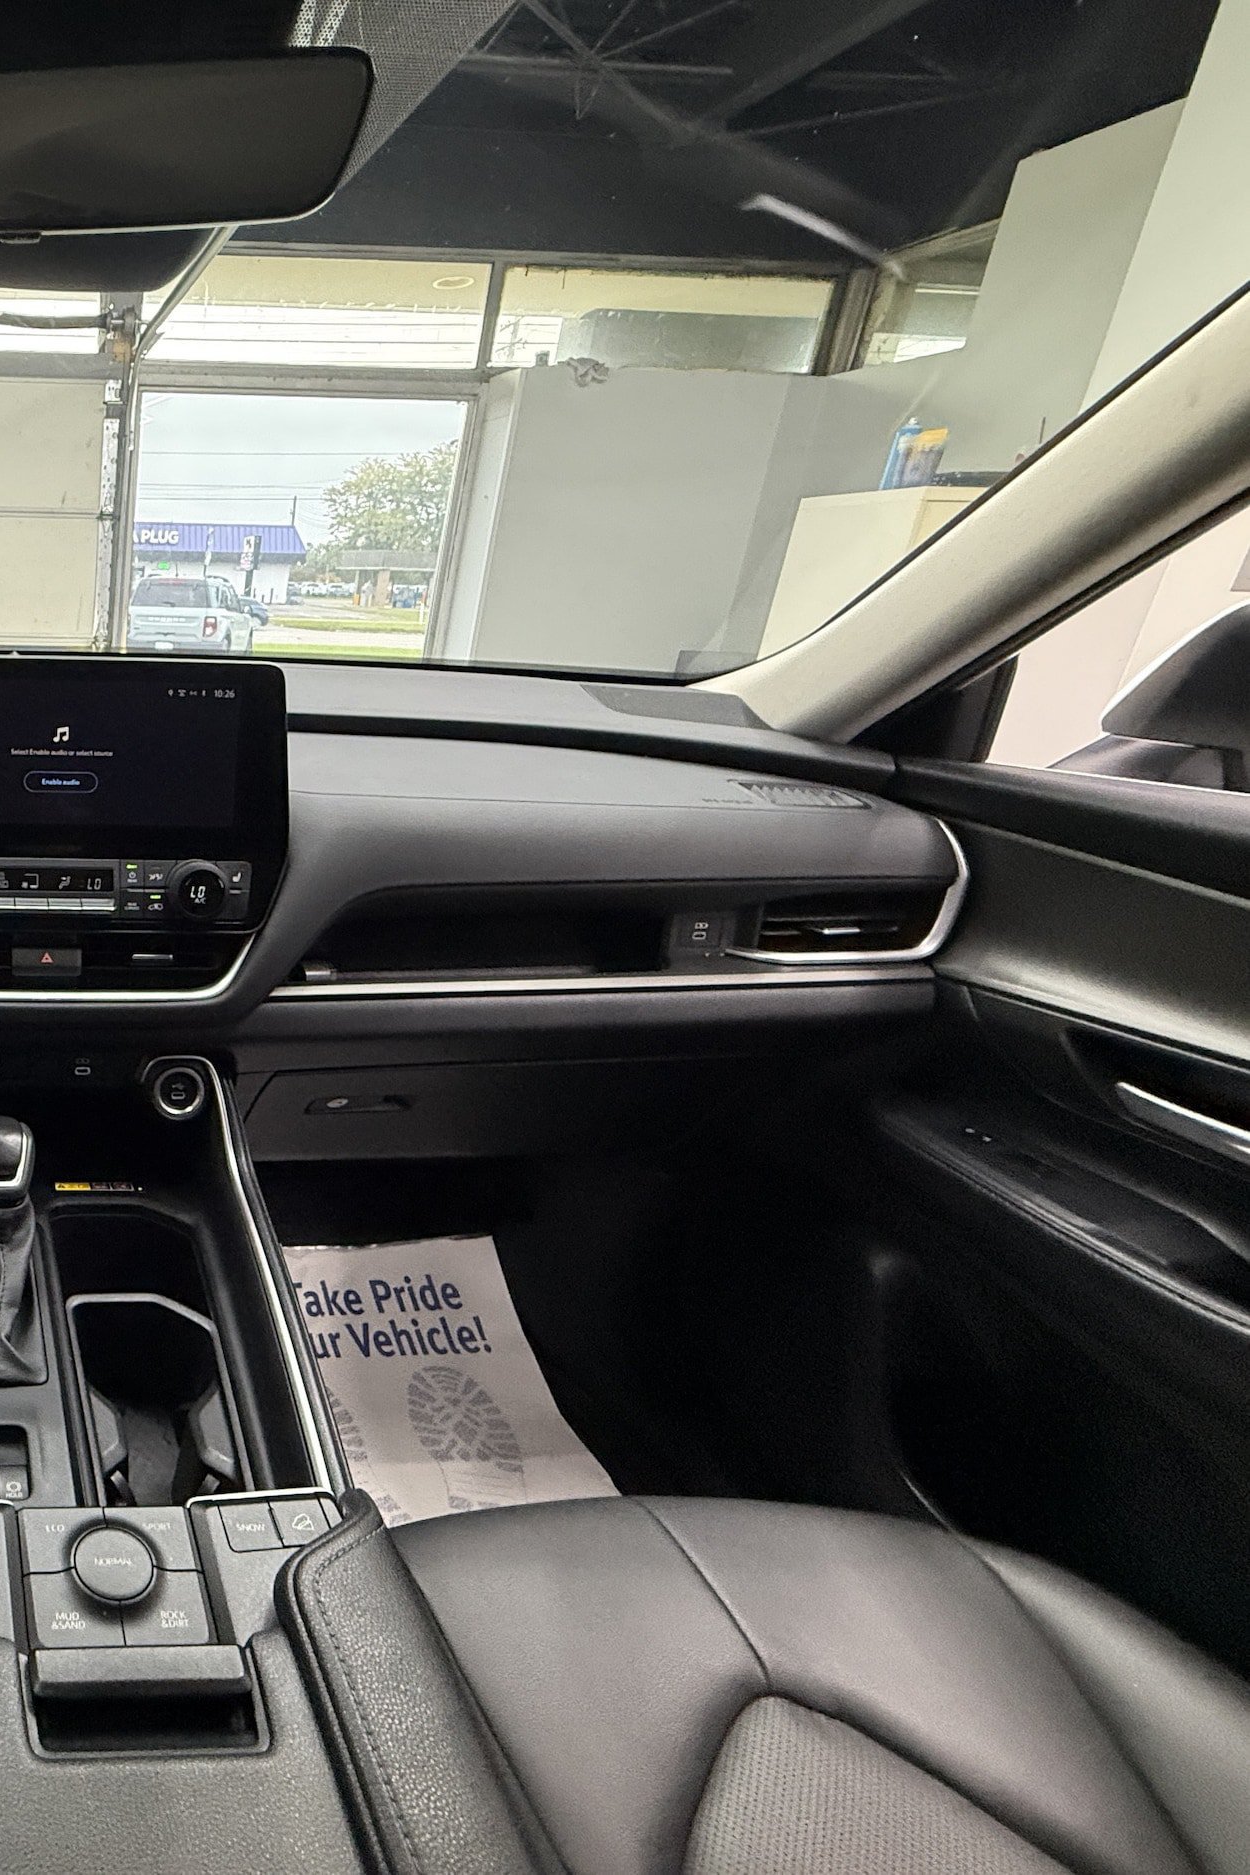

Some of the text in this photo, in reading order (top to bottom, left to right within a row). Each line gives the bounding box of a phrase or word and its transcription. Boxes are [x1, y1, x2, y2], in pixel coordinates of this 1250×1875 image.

[141, 528, 179, 544] PLUG
[214, 689, 236, 698] 10:26
[11, 748, 29, 756] Select
[30, 748, 50, 756] Enable
[41, 778, 80, 786] Enable audio
[87, 878, 102, 890] LO
[190, 886, 206, 898] LO
[369, 1274, 464, 1314] Pride
[308, 1315, 493, 1359] ur Vehicle!
[236, 1523, 265, 1532] SNOW
[55, 1611, 80, 1621] MUD
[160, 1610, 186, 1620] ROCK
[51, 1620, 86, 1630] &SAND
[161, 1618, 190, 1628] &DIRT
